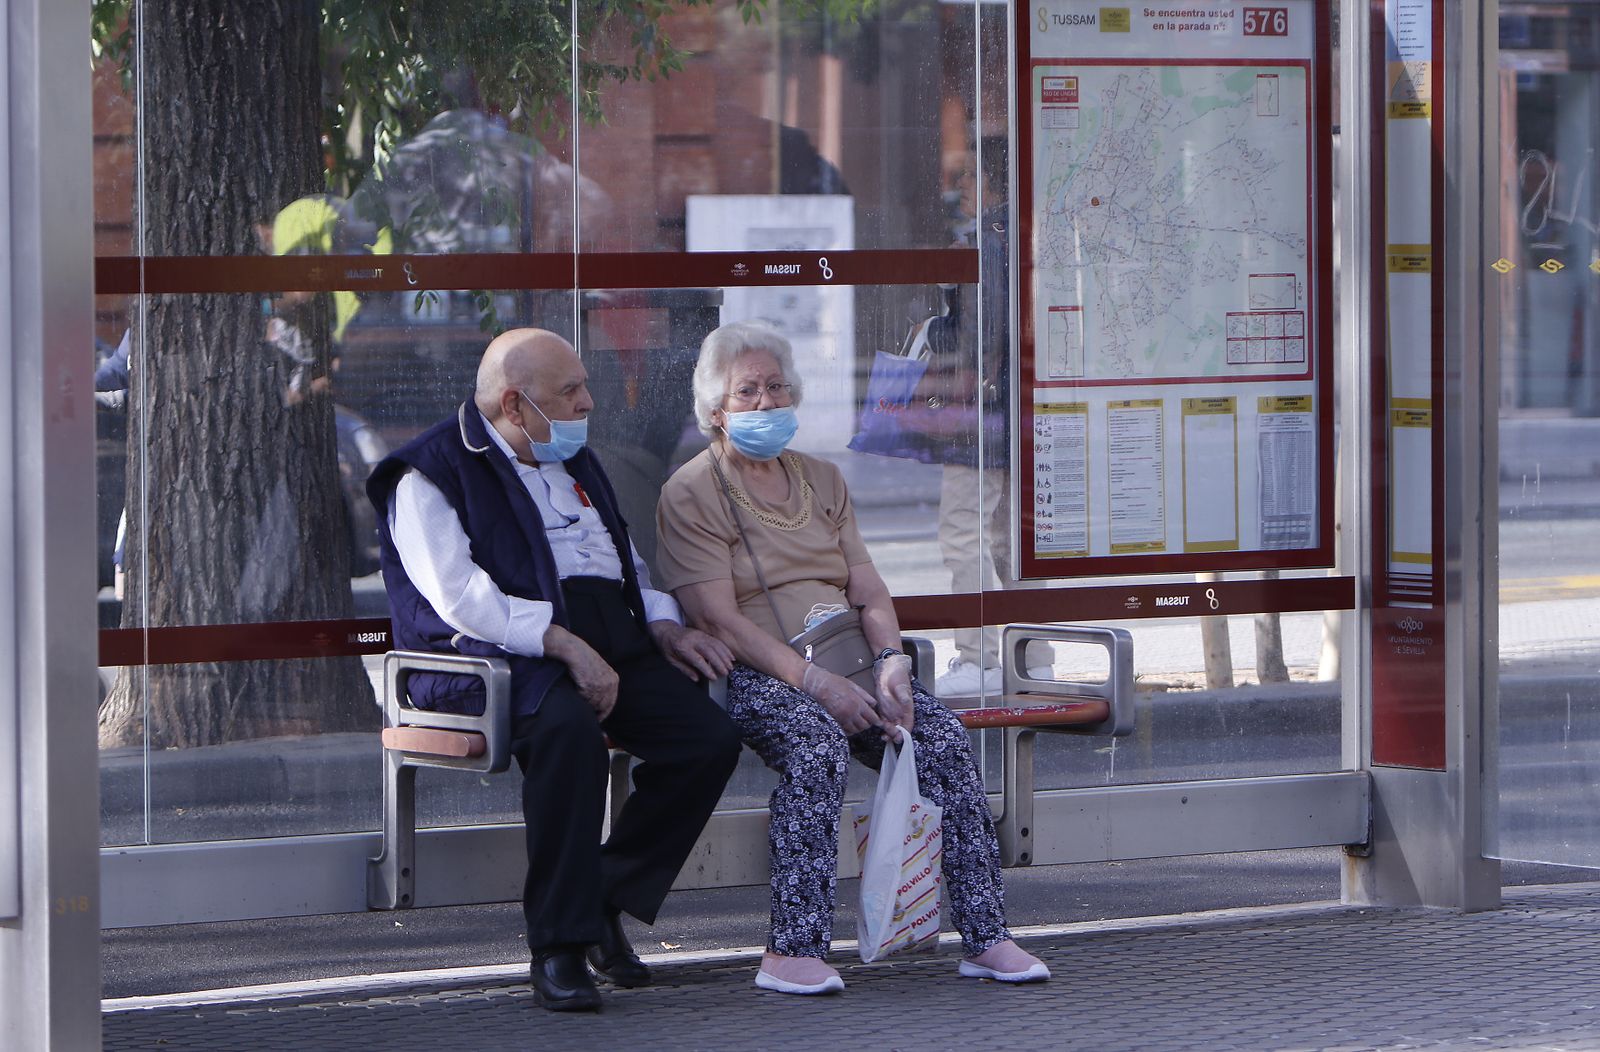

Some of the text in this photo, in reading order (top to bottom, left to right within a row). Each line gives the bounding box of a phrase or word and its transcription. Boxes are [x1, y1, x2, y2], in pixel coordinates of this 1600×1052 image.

[1143, 8, 1235, 18] Se encuentra usted
[1052, 14, 1096, 25] TUSSAM
[1244, 10, 1286, 33] 576
[1153, 22, 1164, 30] en
[1167, 21, 1176, 30] la
[1178, 21, 1211, 32] parada
[897, 867, 931, 896] POLVILLO
